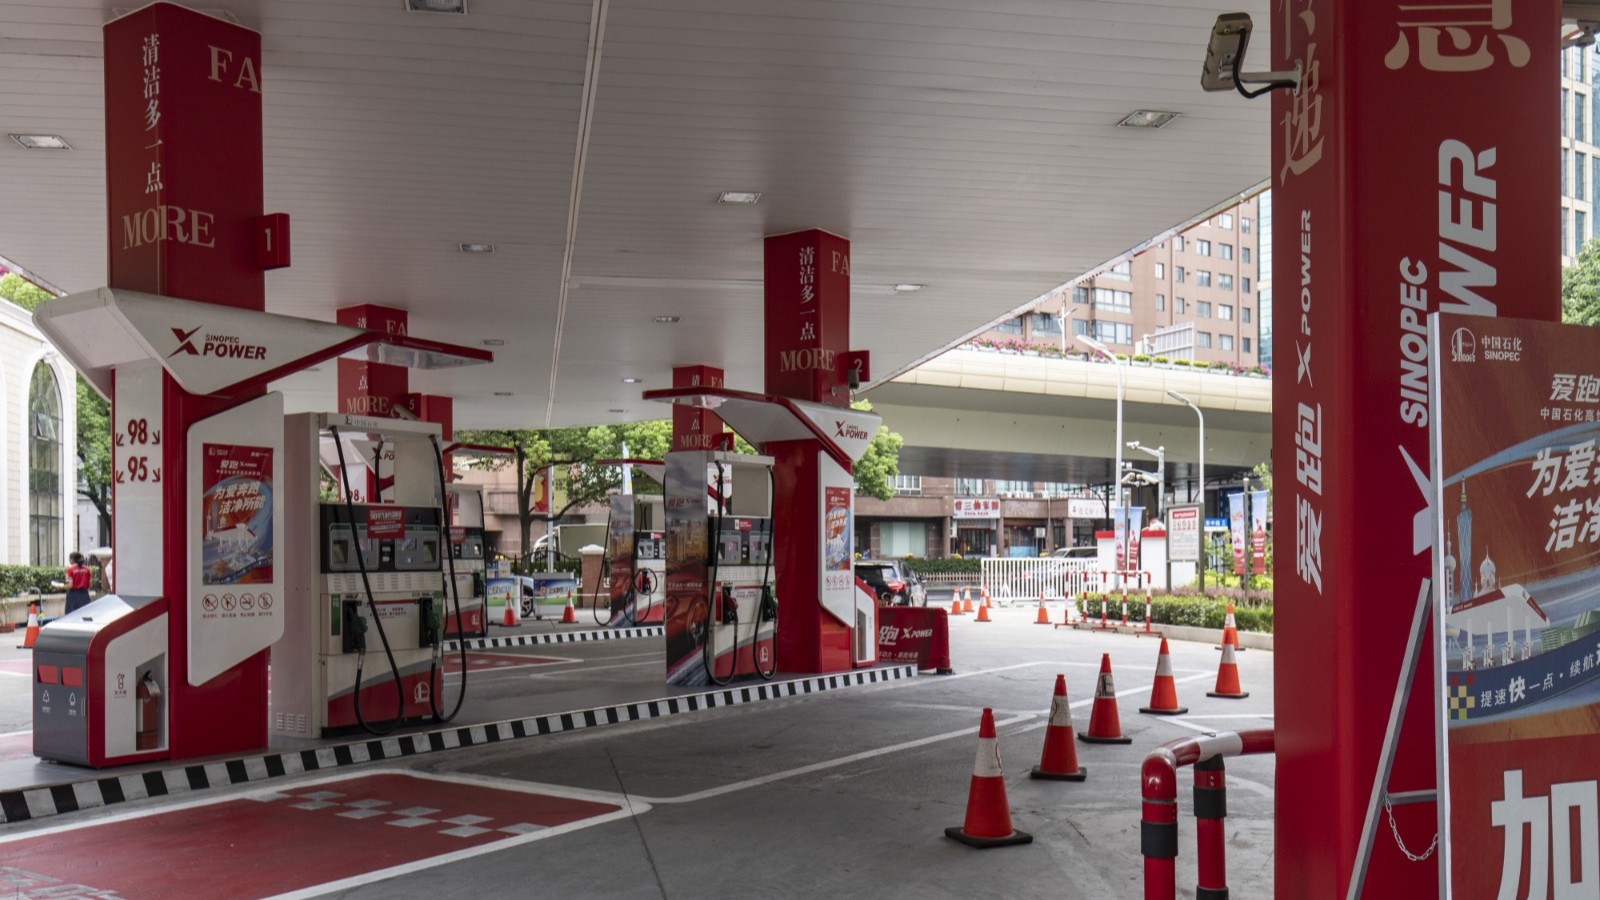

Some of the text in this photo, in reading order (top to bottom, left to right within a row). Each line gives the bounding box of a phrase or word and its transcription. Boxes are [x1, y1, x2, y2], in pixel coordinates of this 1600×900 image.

[142, 33, 164, 195] 清洁多一点
[123, 204, 215, 251] MORE
[264, 227, 272, 253] 1
[1301, 208, 1312, 336] POWER
[799, 246, 816, 341] 清洁多一点
[202, 342, 267, 361] POWER
[205, 333, 240, 344] SINOPEC
[1399, 255, 1428, 426] SINOPEC
[1481, 335, 1522, 351] 中国石化
[779, 347, 835, 373] MORE
[854, 358, 863, 373] 2
[1484, 350, 1520, 362] SINOPEC
[1550, 373, 1600, 403] 爱跑
[346, 395, 389, 414] MORE
[409, 398, 415, 410] 5
[127, 418, 148, 445] 98
[680, 434, 713, 449] MORE
[845, 429, 868, 441] POWER
[127, 455, 148, 482] 95
[911, 629, 933, 639] POWER
[1491, 768, 1600, 900] 加
